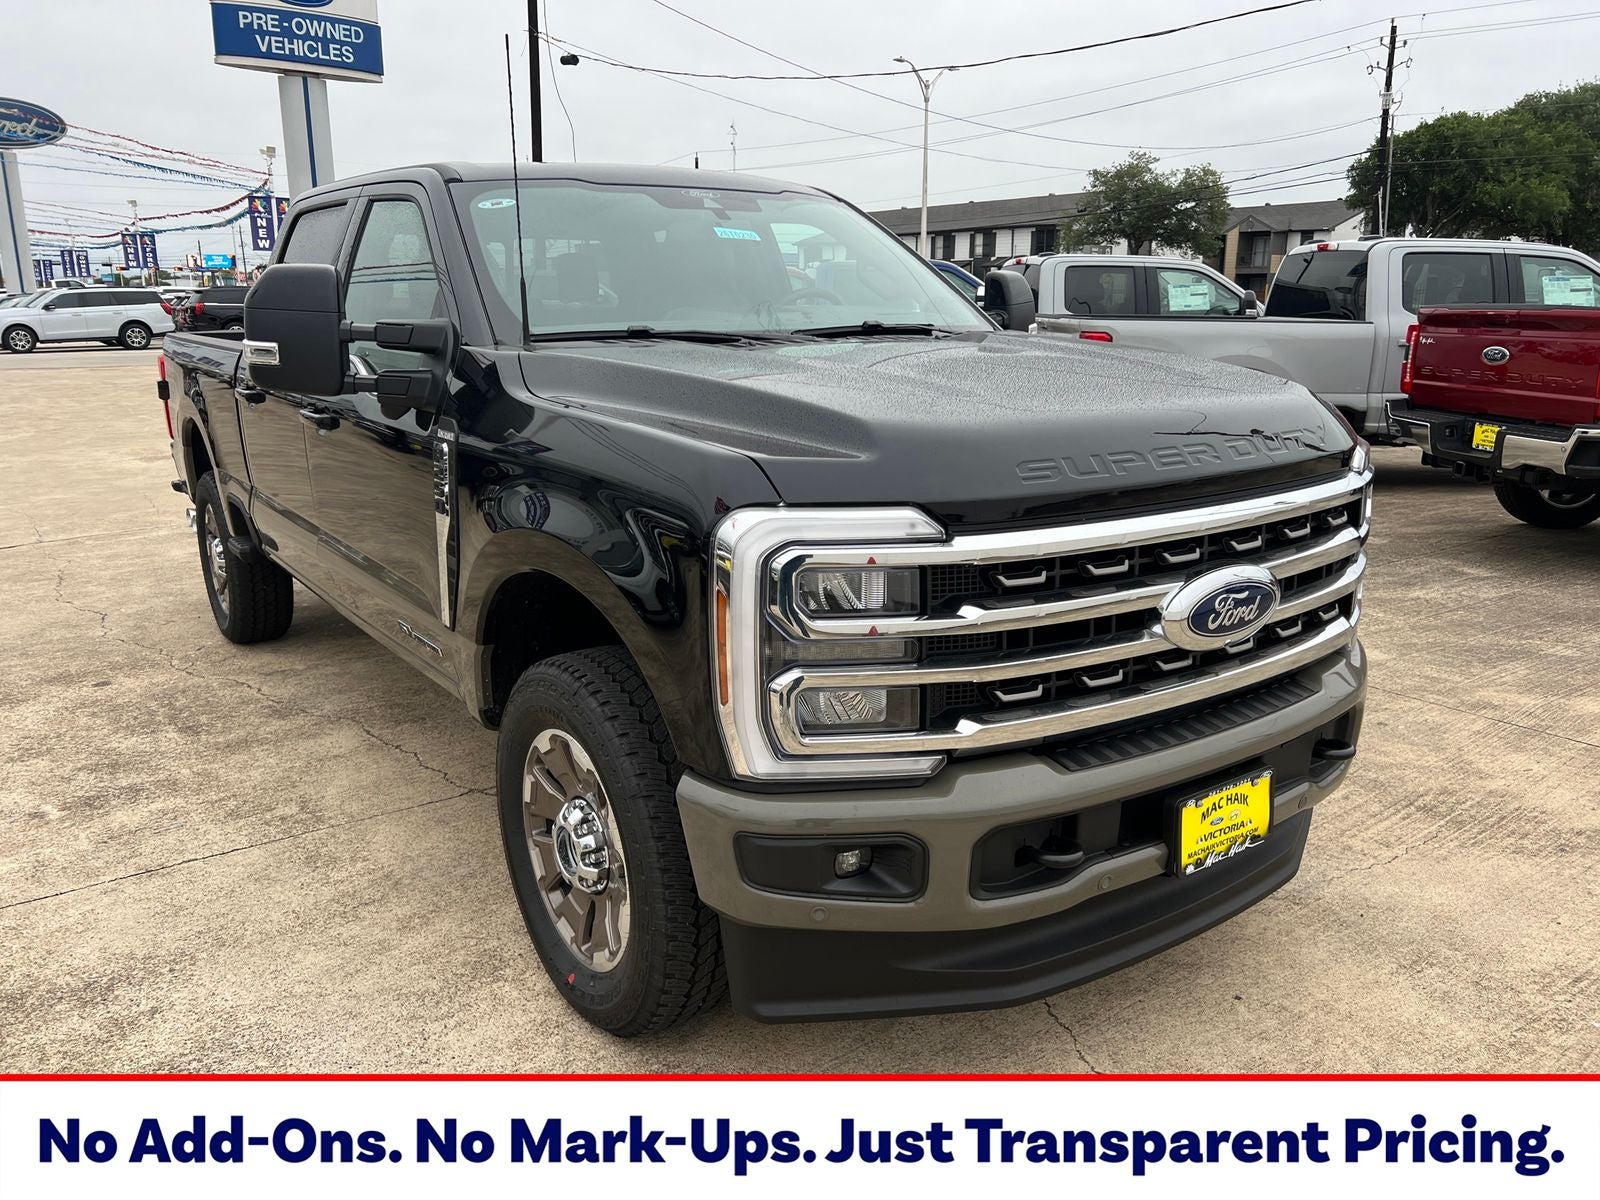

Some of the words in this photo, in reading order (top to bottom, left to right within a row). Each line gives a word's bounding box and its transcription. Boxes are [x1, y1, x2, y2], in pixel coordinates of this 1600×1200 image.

[255, 34, 354, 63] VEHICLES
[256, 217, 270, 249] NEW
[127, 247, 137, 267] NEW
[145, 247, 155, 268] FORD
[1505, 371, 1584, 389] DUTY
[1015, 442, 1223, 484] SUPER
[1224, 424, 1327, 461] DUTY
[1207, 590, 1260, 631] Ford
[1201, 797, 1224, 824] MAC
[1226, 792, 1249, 807] HAIK
[1202, 820, 1245, 842] VICTORIA
[1204, 850, 1228, 868] Mac
